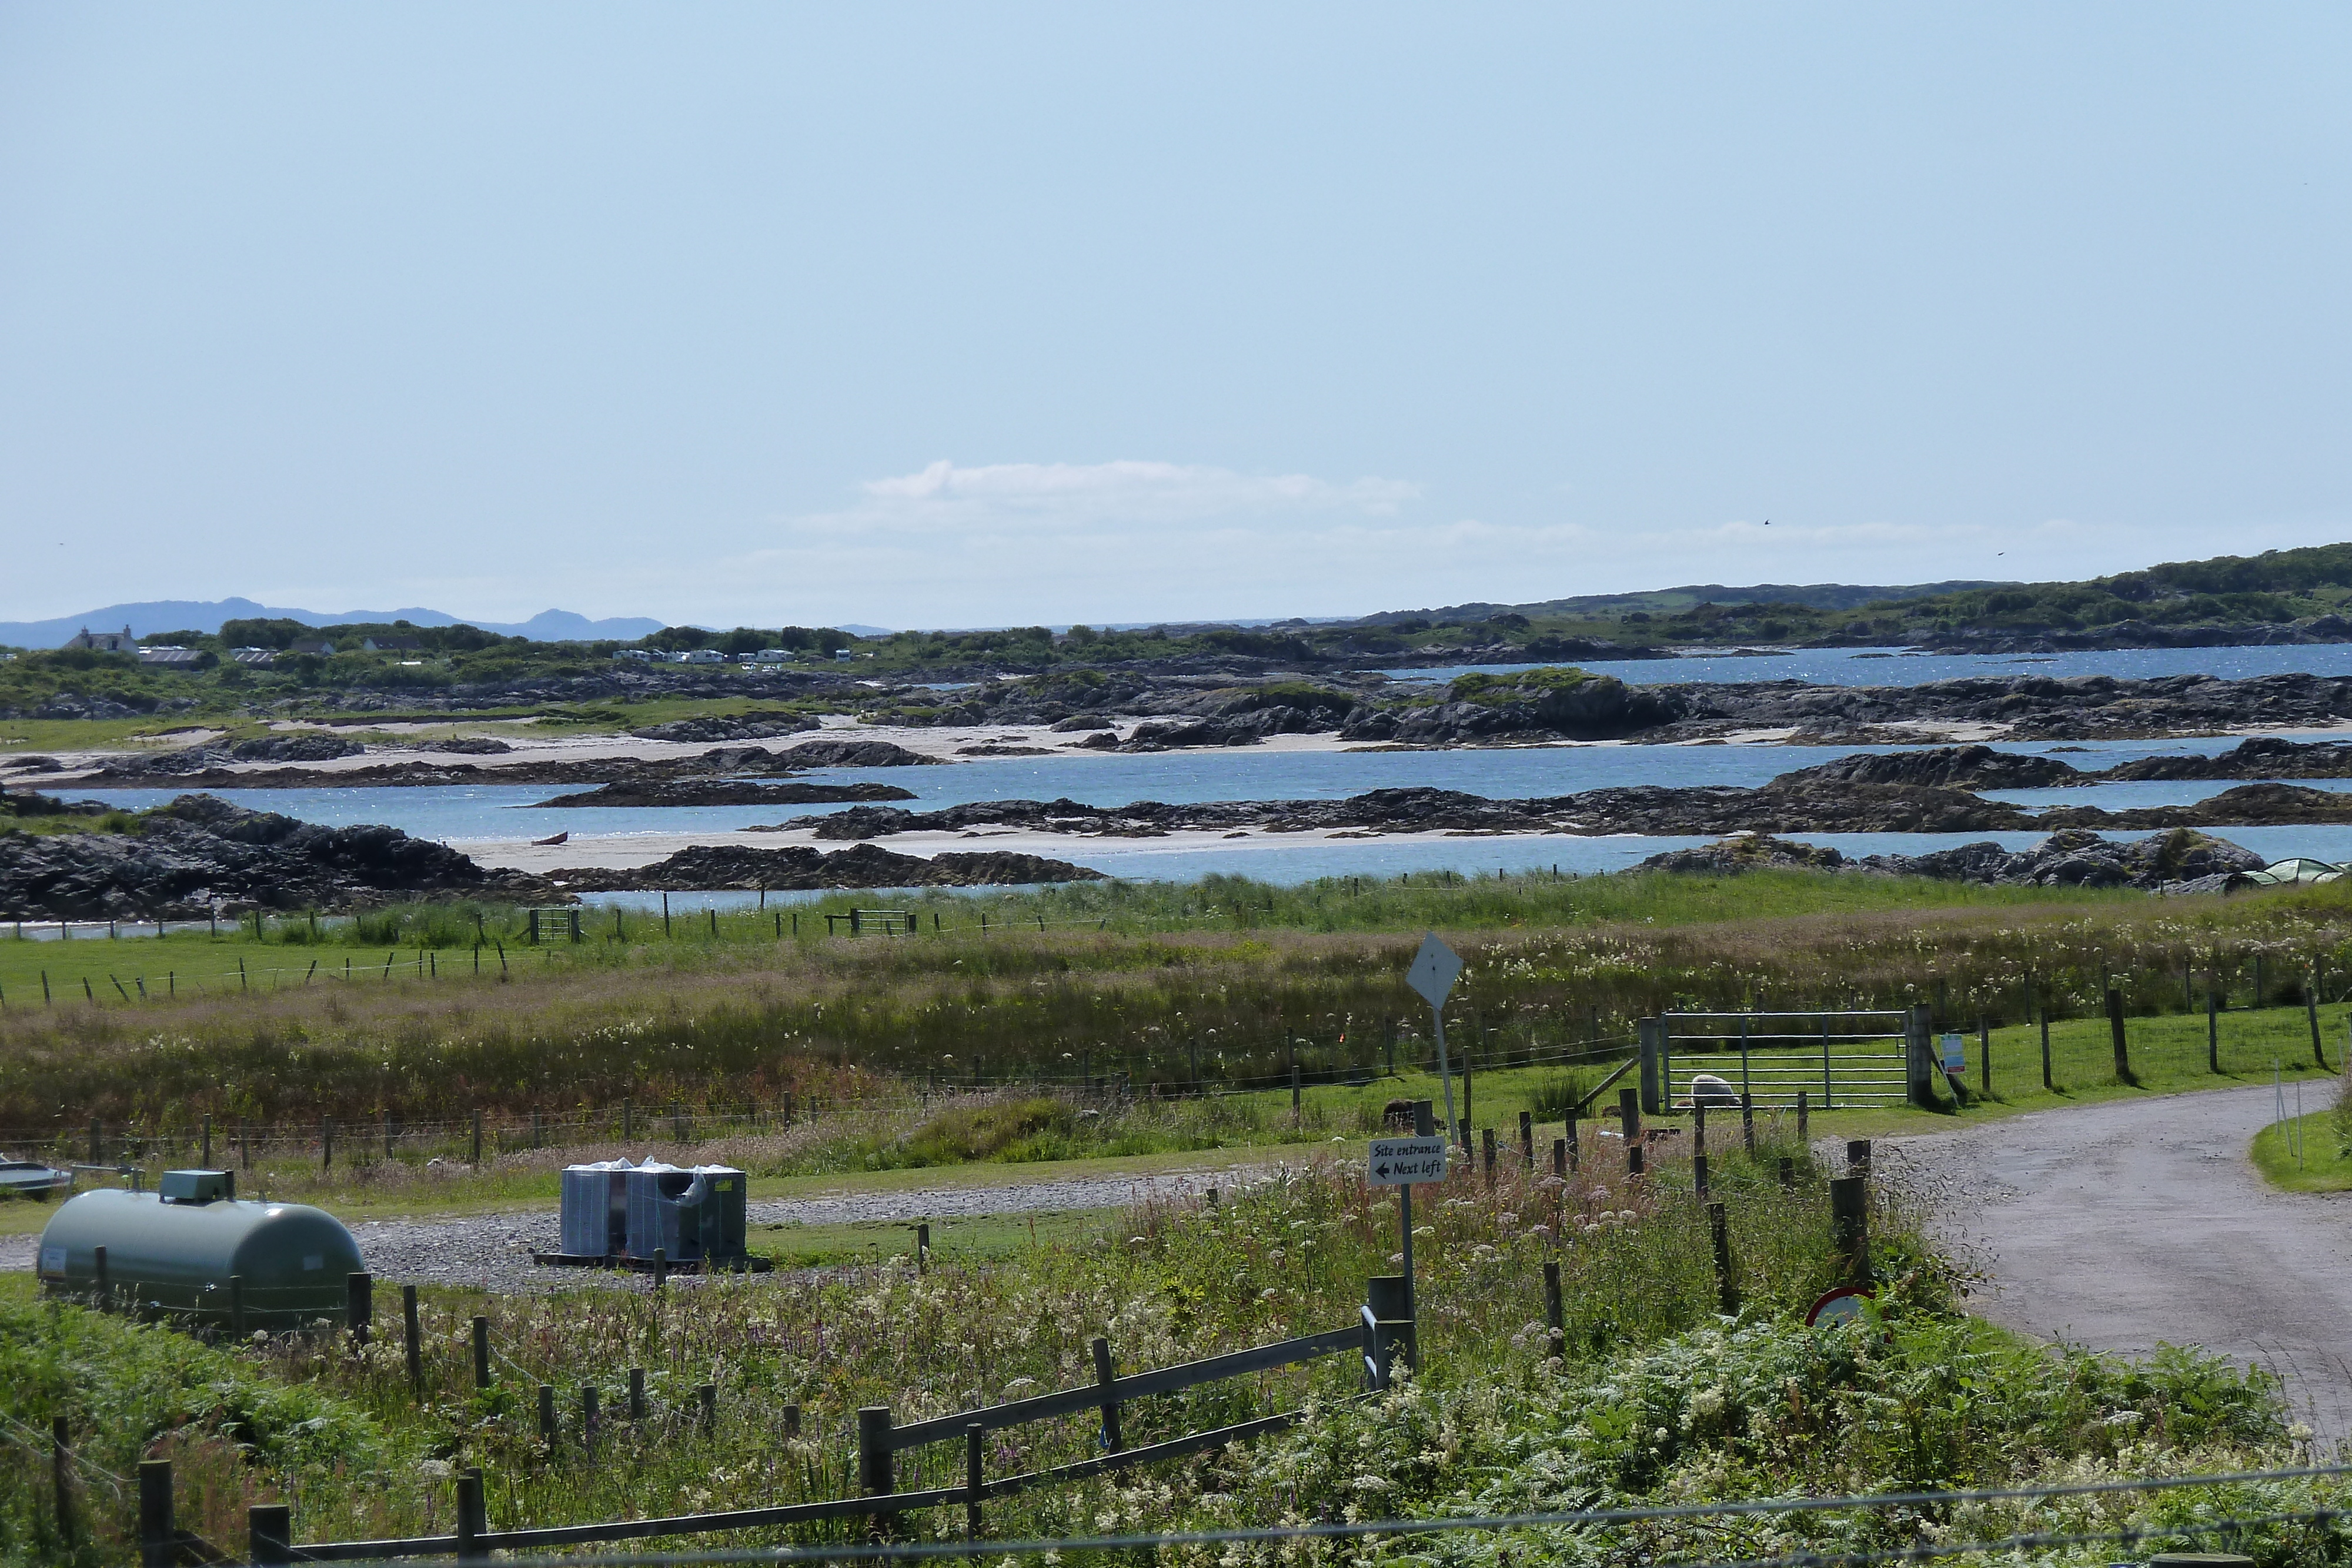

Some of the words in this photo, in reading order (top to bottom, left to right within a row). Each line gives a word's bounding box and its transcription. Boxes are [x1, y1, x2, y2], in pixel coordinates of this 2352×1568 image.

[1374, 1144, 1393, 1157] Site
[1397, 1144, 1441, 1156] entrance
[1394, 1162, 1418, 1175] Next
[1422, 1159, 1441, 1177] left
